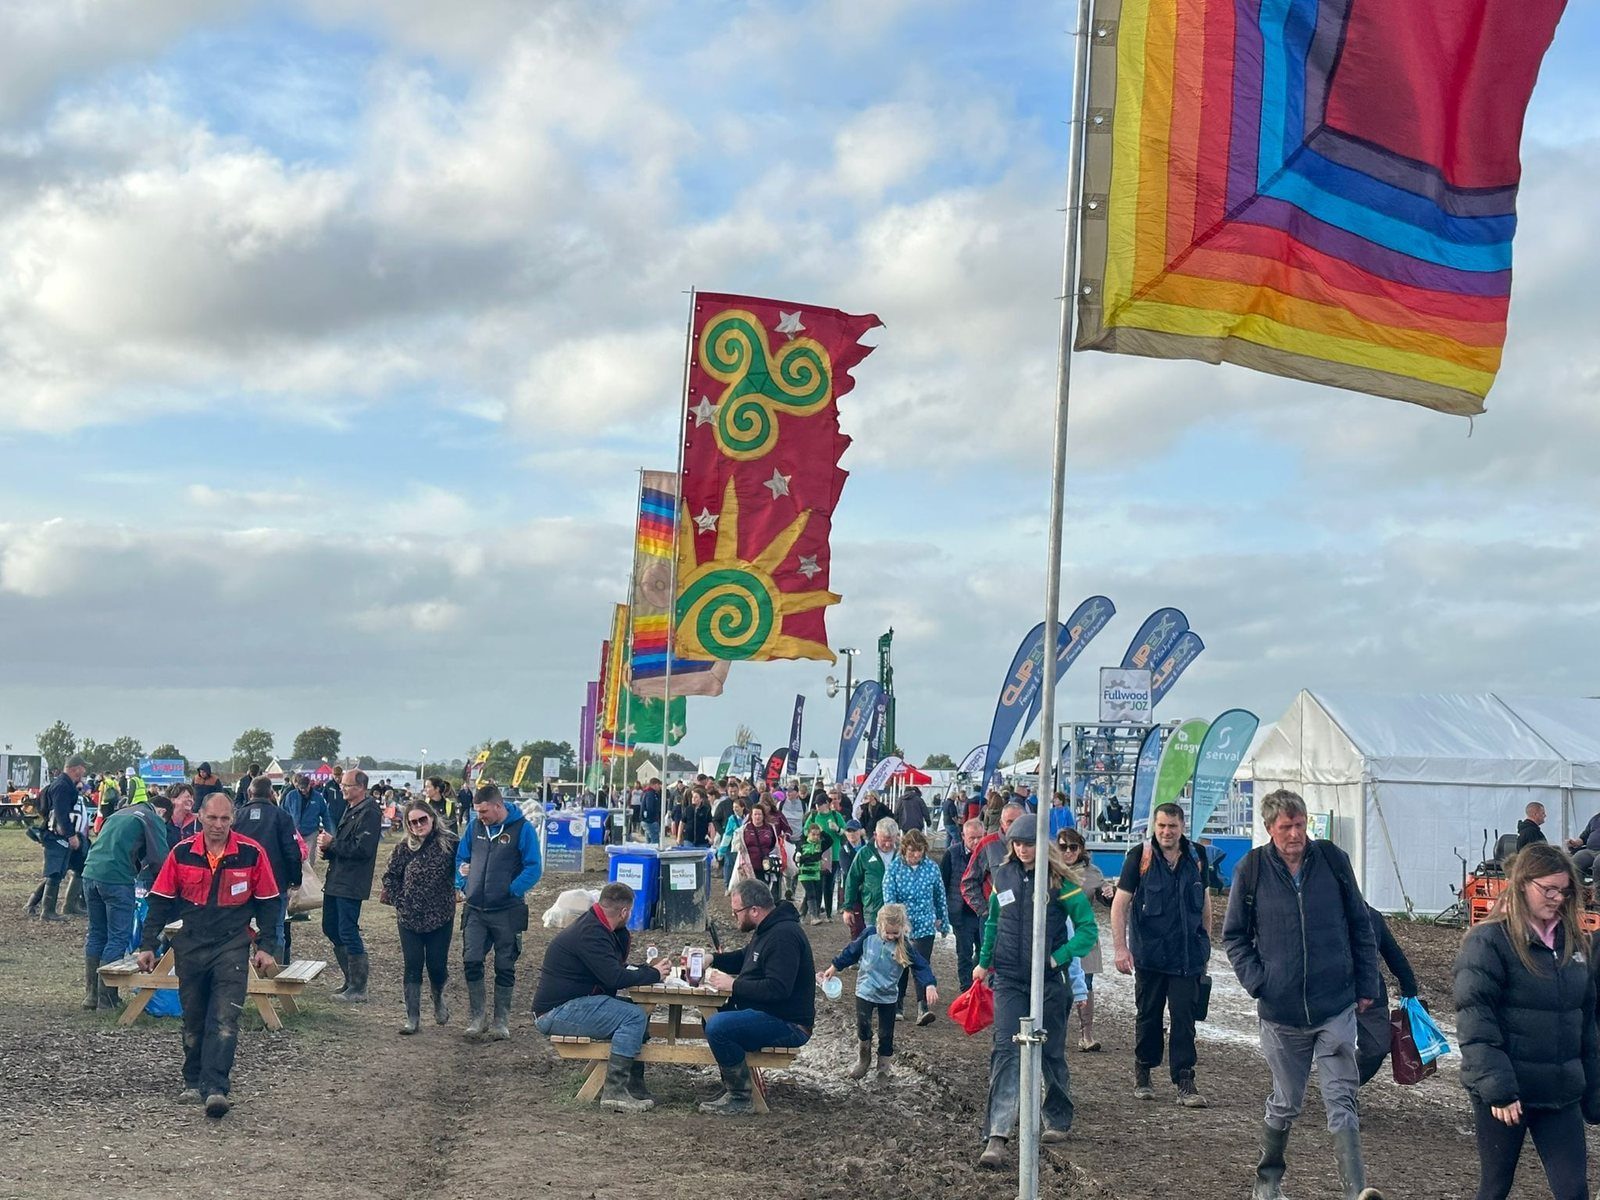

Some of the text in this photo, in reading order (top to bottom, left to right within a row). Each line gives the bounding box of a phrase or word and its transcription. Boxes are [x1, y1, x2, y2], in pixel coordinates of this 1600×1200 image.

[1103, 690, 1149, 700] Fullwood
[1130, 701, 1149, 711] JOZ
[1206, 751, 1241, 761] serval
